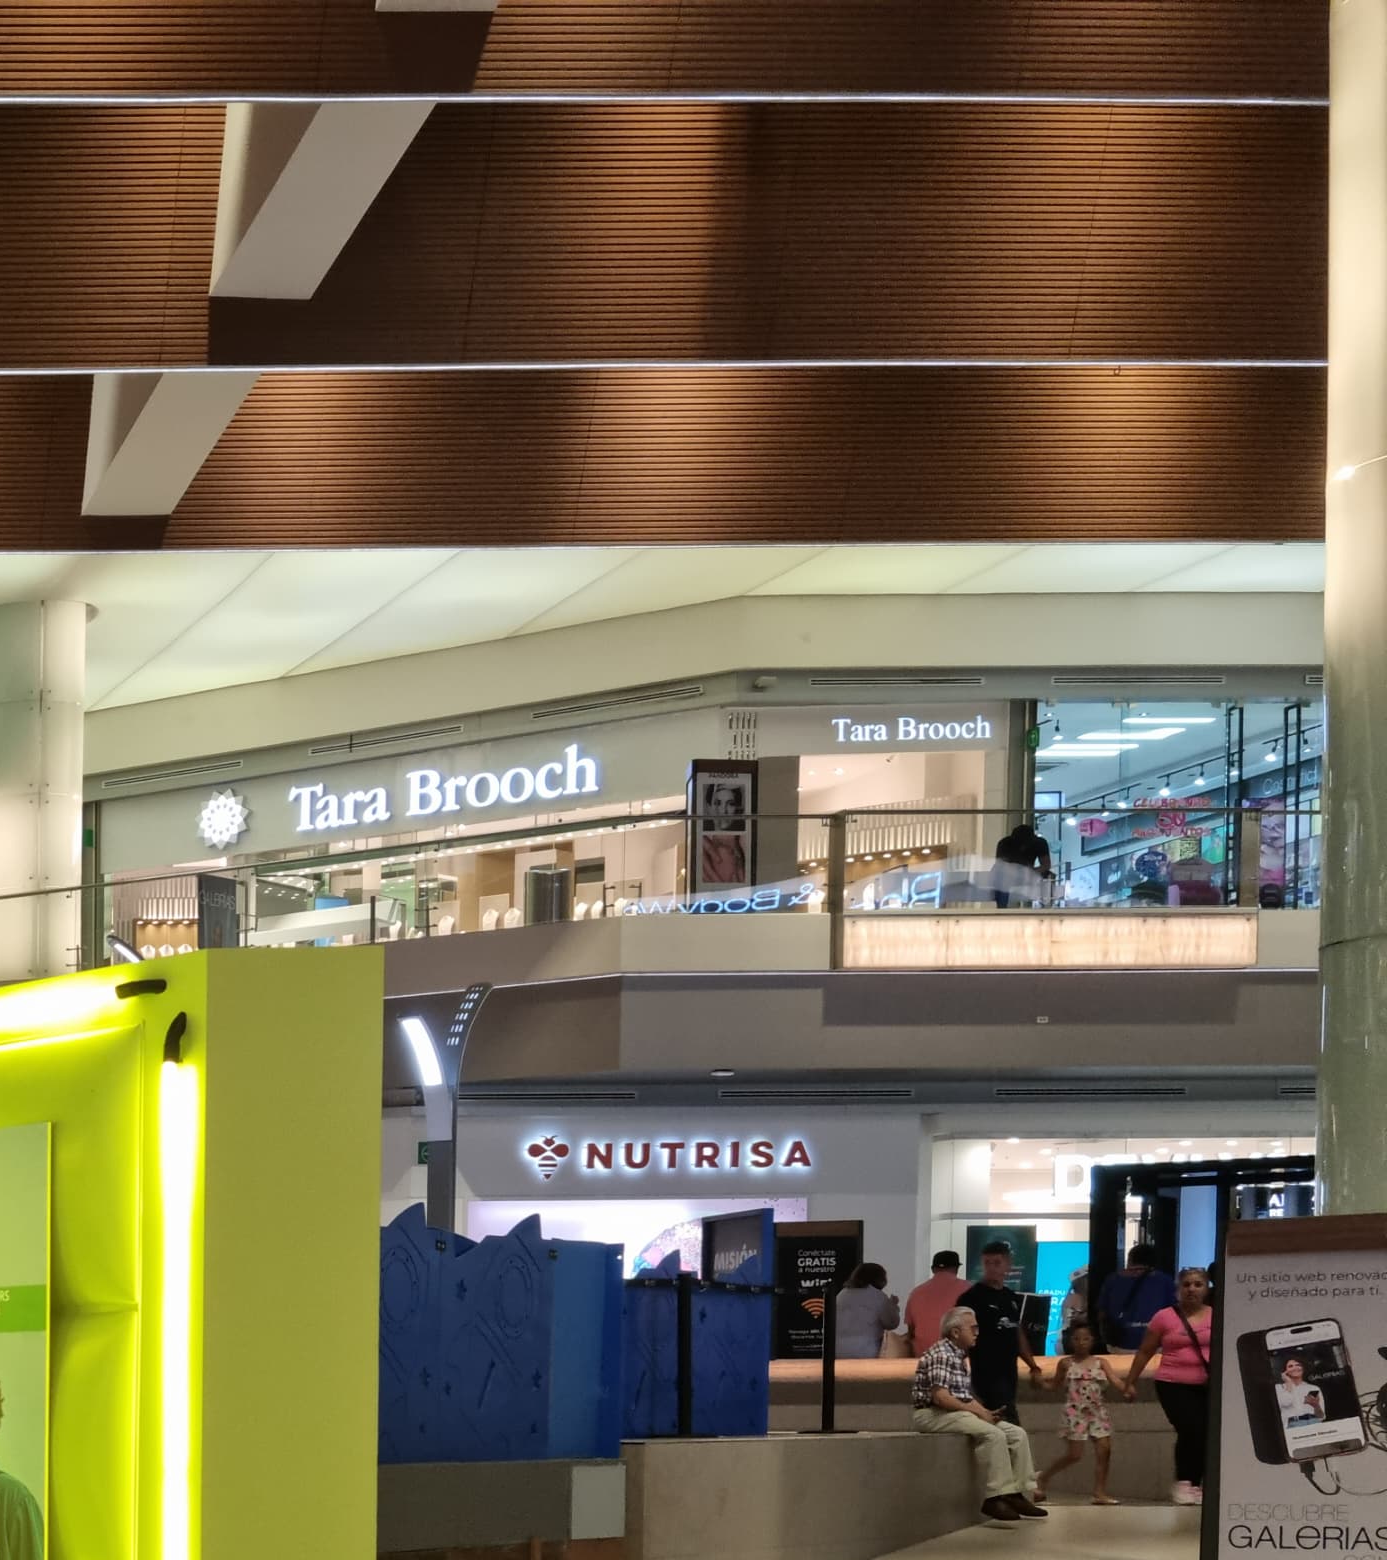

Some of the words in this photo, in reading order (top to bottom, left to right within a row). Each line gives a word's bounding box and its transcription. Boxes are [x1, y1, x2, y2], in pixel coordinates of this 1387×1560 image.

[831, 718, 887, 742] Tara
[897, 715, 991, 740] Brooch
[288, 783, 391, 832] Tara
[405, 744, 599, 817] Brooch
[586, 1141, 812, 1169] NUTRISA
[797, 1257, 836, 1267] GRATIS
[1236, 1272, 1257, 1283] Un
[1260, 1271, 1290, 1283] sitio
[1294, 1271, 1327, 1282] web
[1248, 1289, 1257, 1300] y
[1260, 1286, 1328, 1298] diseñado
[1332, 1287, 1364, 1298] para
[1228, 1503, 1348, 1521] DESCUBRE
